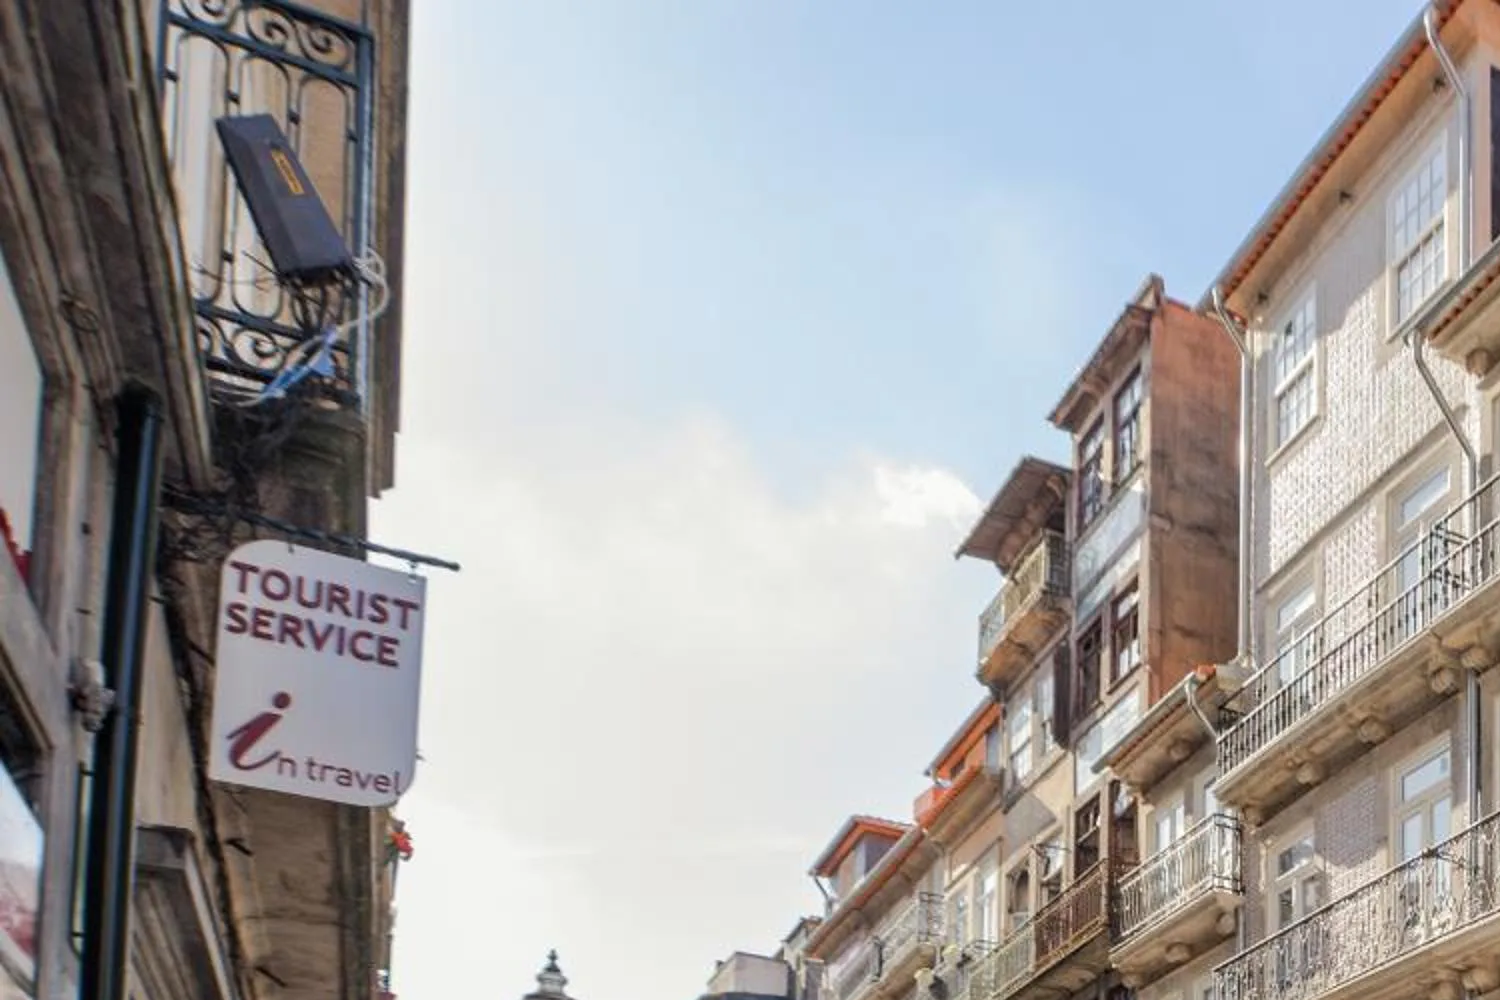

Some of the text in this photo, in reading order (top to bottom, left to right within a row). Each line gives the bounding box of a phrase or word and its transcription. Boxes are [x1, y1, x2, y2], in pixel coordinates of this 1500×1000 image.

[230, 560, 420, 630] TOURIST
[225, 602, 399, 668] SERVICE
[305, 756, 402, 796] travel
